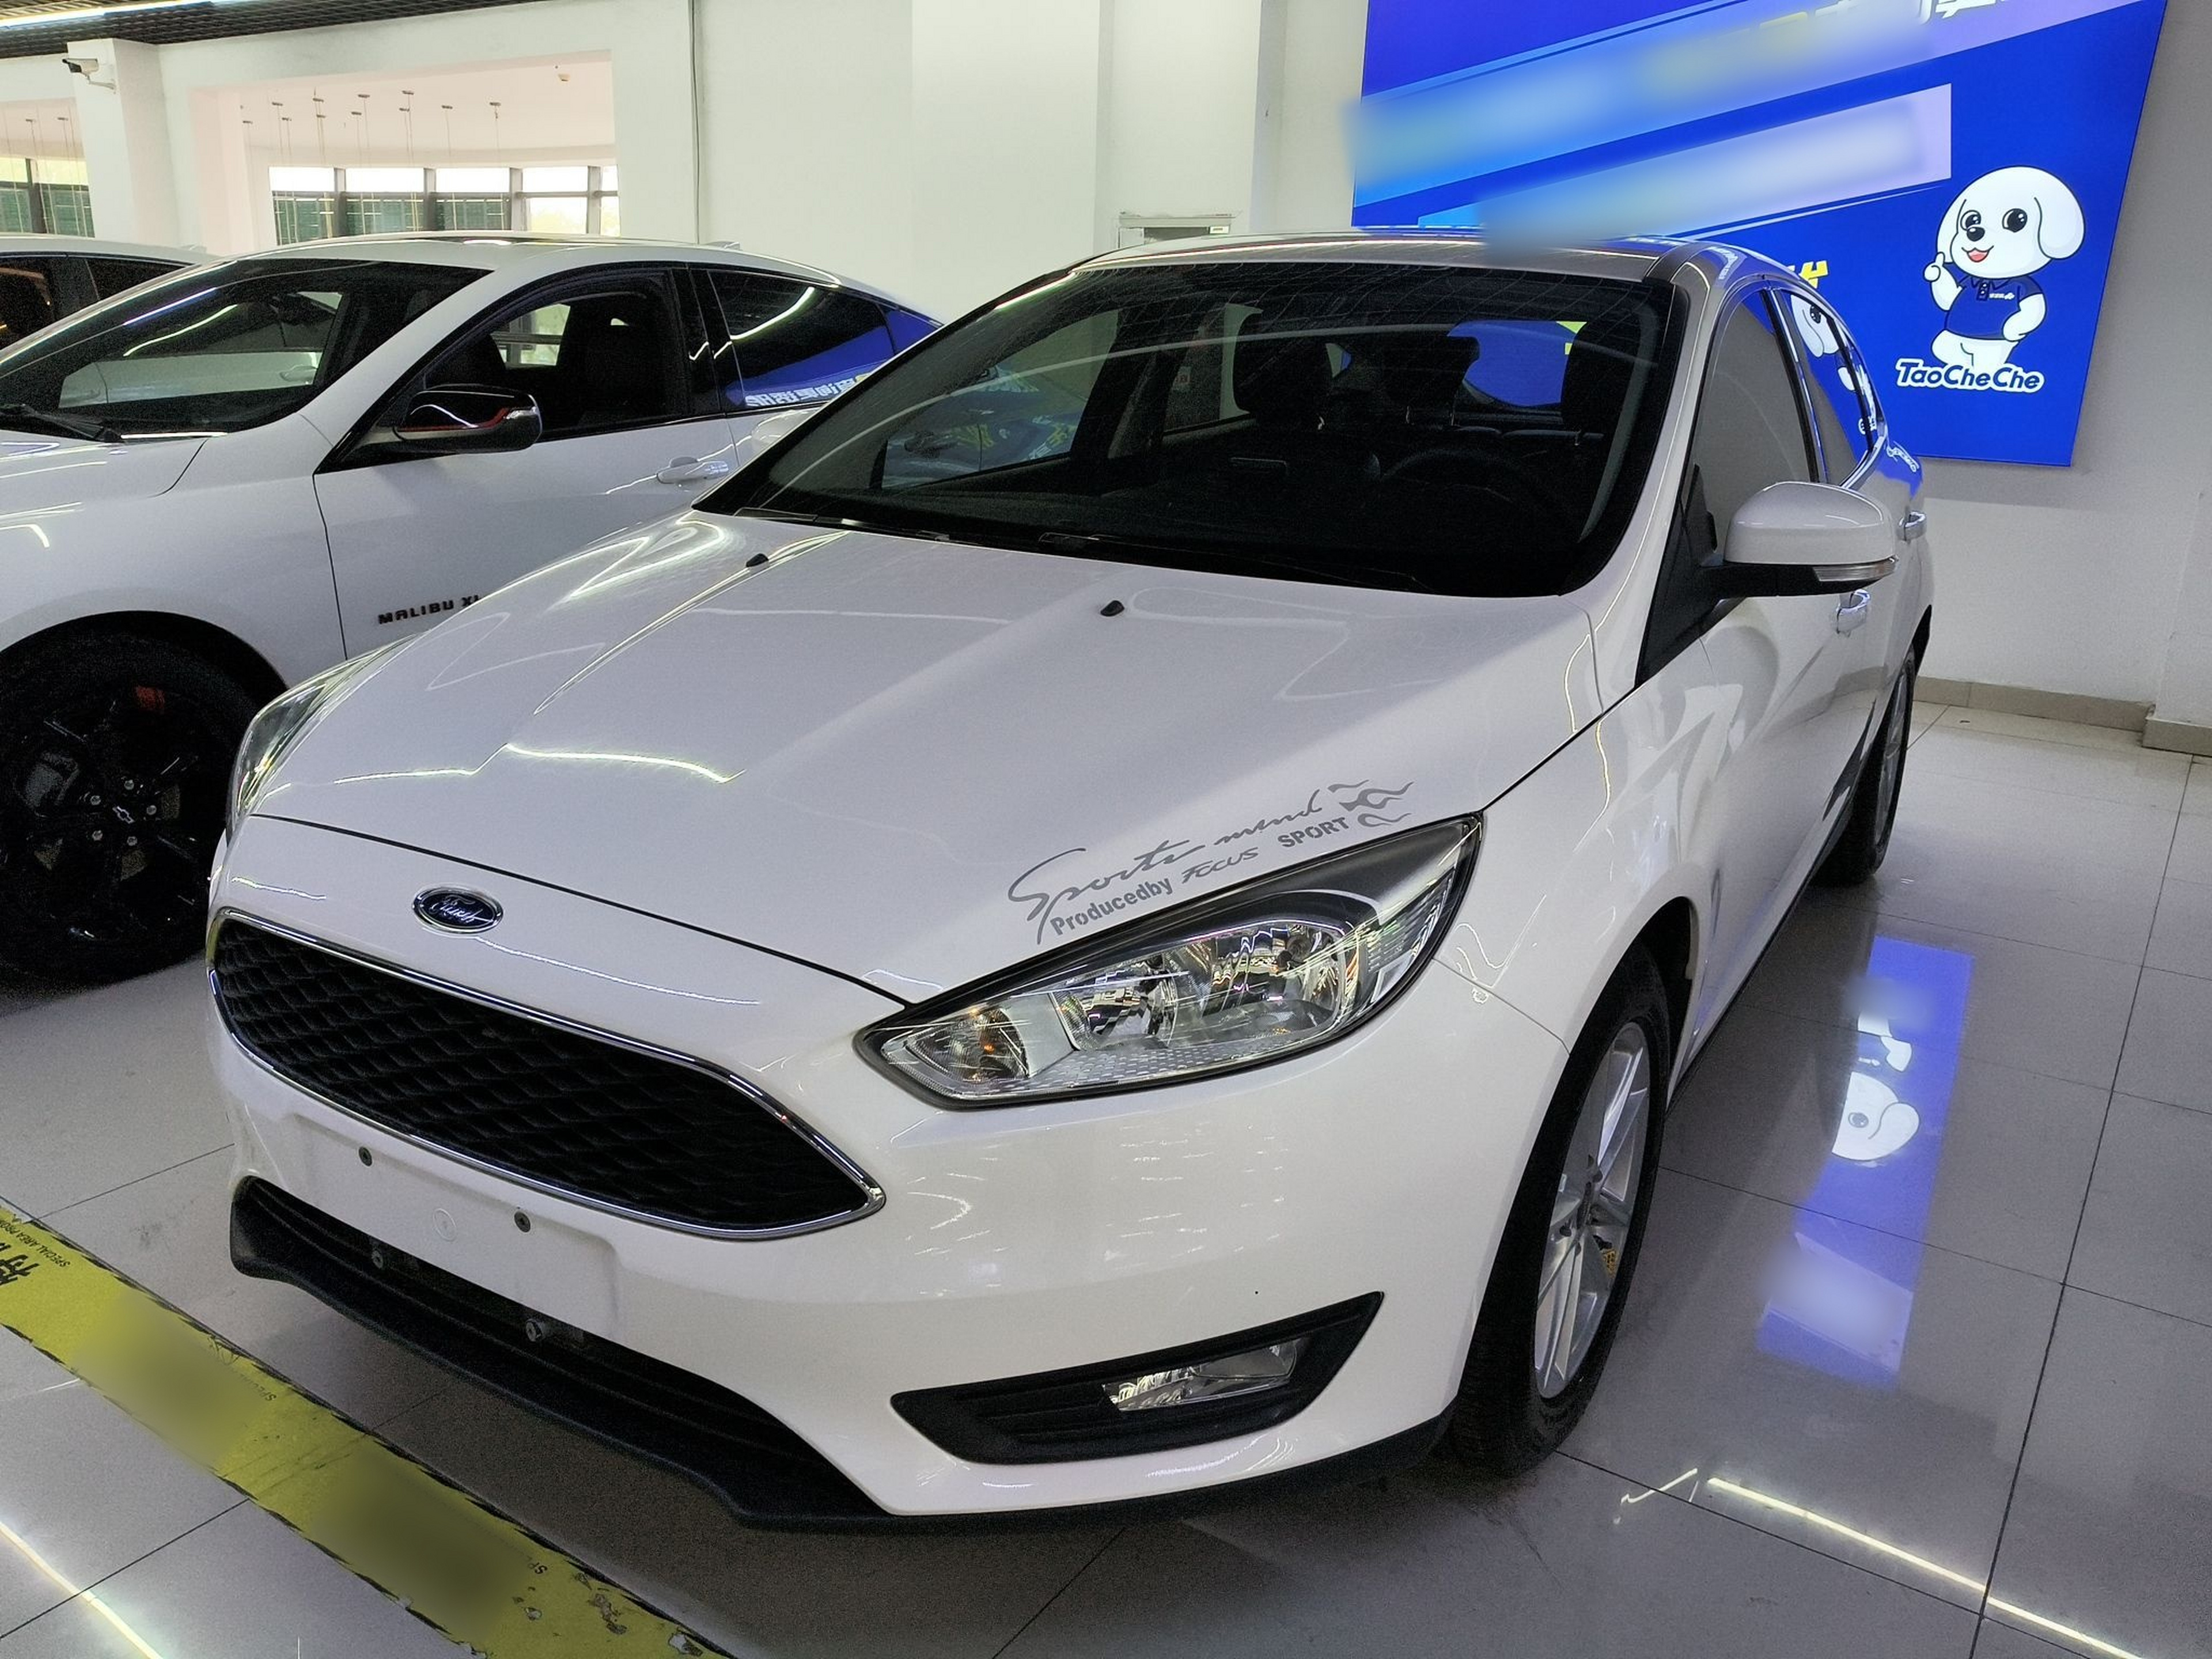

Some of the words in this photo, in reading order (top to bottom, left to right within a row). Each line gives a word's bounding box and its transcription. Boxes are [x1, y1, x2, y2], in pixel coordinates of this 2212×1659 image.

[1898, 360, 2043, 391] TaoCheChe
[378, 600, 454, 624] MALIBU
[1050, 878, 1173, 935] Producedby
[1181, 847, 1259, 884] FOCUS
[1278, 817, 1349, 847] SPORT
